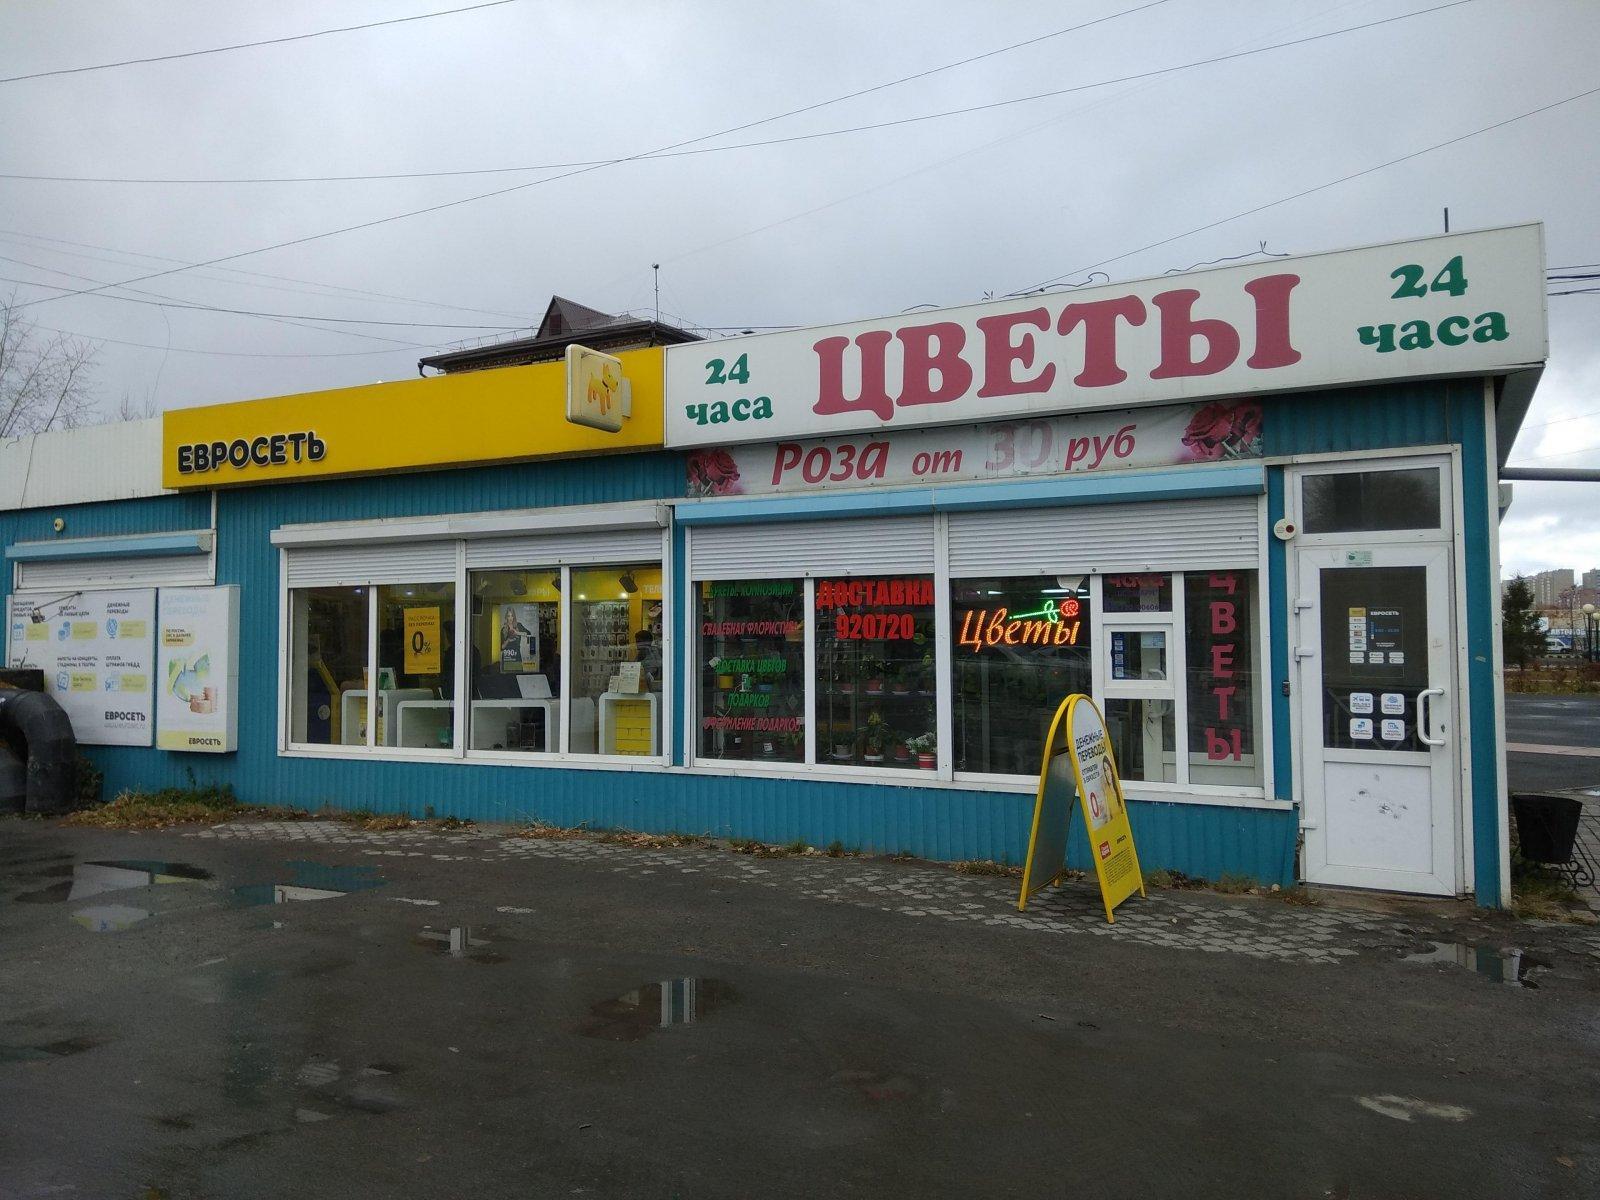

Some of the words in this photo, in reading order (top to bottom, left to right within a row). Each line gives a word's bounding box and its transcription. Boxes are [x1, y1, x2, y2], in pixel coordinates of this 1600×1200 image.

[1390, 255, 1468, 299] 24
[812, 273, 1302, 421] ЦВЕТЫ
[1356, 311, 1510, 353] часа
[704, 353, 751, 385] 24
[685, 395, 774, 425] часа
[177, 431, 326, 473] ЕВРОСЕТЬ
[911, 449, 963, 476] от
[984, 420, 1054, 471] 30
[1065, 425, 1136, 470] руб
[816, 578, 935, 610] ДОСТАВКА
[702, 621, 745, 635] СВАДЕБНАЯ
[835, 613, 916, 640] 920720
[960, 607, 1080, 653] Цветы
[728, 692, 771, 708] ПОДАРКОВ
[104, 711, 146, 721] ЕВРОСЕТЬ
[188, 737, 221, 746] ЕВРОСЕТЬ
[1075, 729, 1104, 750] ДЕНЕЖНЫЕ
[1077, 741, 1107, 763] ПЕРЕВОДЫ
